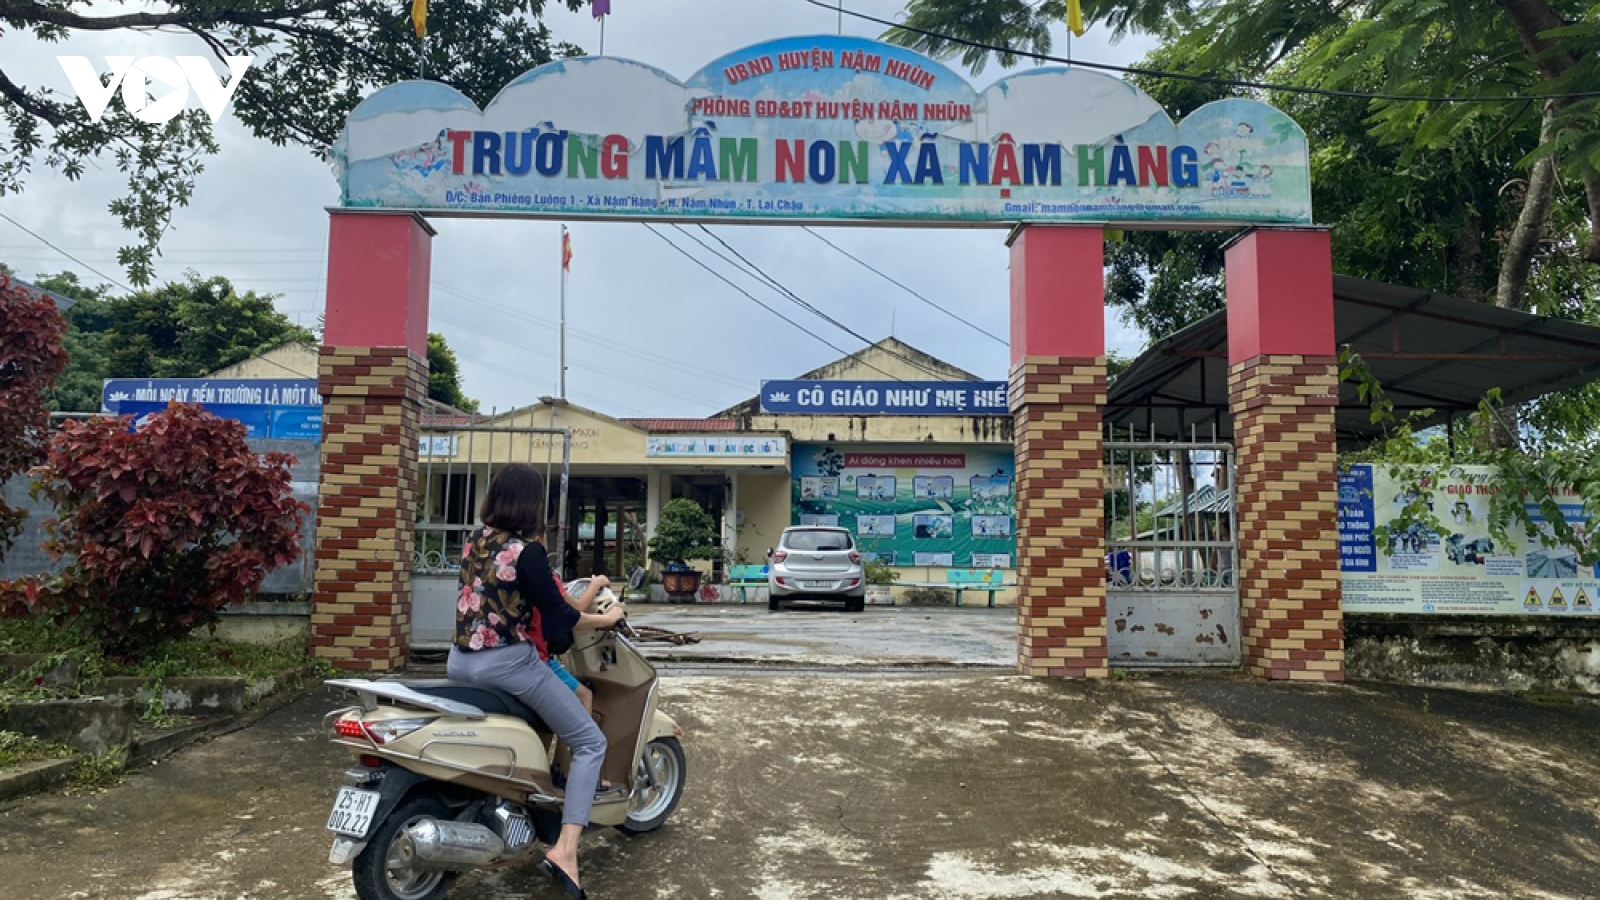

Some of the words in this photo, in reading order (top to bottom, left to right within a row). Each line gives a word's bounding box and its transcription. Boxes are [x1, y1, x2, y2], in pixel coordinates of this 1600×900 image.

[724, 55, 774, 85] UBND
[778, 48, 834, 71] HUYỆN
[840, 50, 881, 73] NẬM
[756, 100, 812, 118] GD&ĐT
[816, 98, 874, 121] HUYỆN
[877, 99, 918, 122] NẬM
[446, 122, 628, 178] TRƯỜNG
[646, 120, 758, 180] MẦM
[775, 139, 868, 184] NON
[884, 133, 944, 184] XÃ
[959, 133, 1062, 198] NẬM
[1077, 134, 1200, 186] HÀNG
[218, 384, 262, 404] TRƯỜNG
[265, 384, 279, 405] LÀ
[282, 384, 306, 405] MỘT
[797, 385, 824, 406] CÔ
[831, 386, 879, 406] GIÁO
[886, 388, 931, 406] NHƯ
[936, 388, 967, 410] MẸ
[888, 456, 912, 466] khen
[339, 791, 373, 813] 25-H1
[330, 810, 368, 834] 002.22
